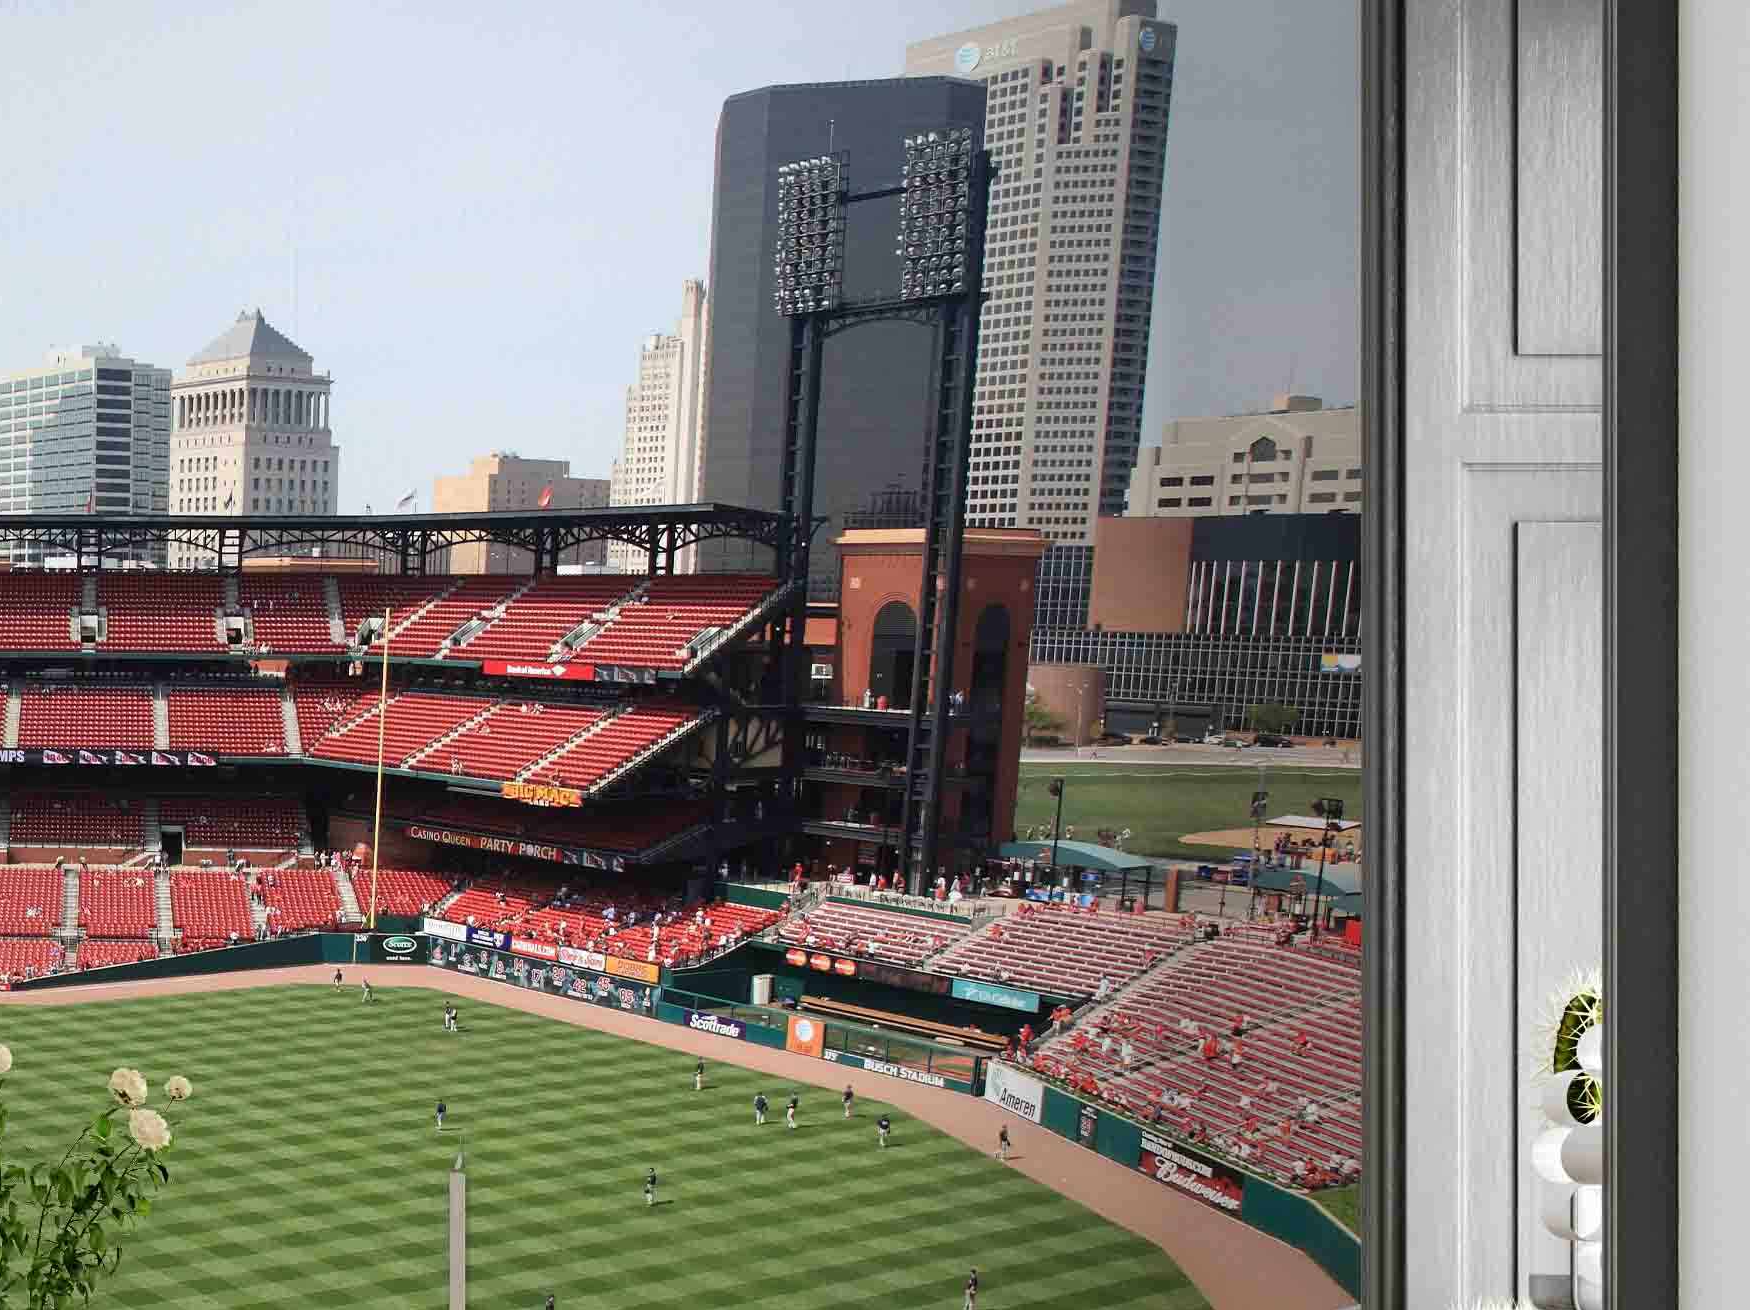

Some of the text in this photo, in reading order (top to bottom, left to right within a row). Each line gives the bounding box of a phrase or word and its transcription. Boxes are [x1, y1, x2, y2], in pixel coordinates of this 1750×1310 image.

[480, 837, 515, 854] PARTY
[519, 842, 557, 861] PORCH
[689, 1014, 740, 1038] Scottrade
[863, 1058, 945, 1087] BUSCH STADIUM
[1000, 1087, 1037, 1118] Ameren
[1154, 1156, 1241, 1209] Budweiser
